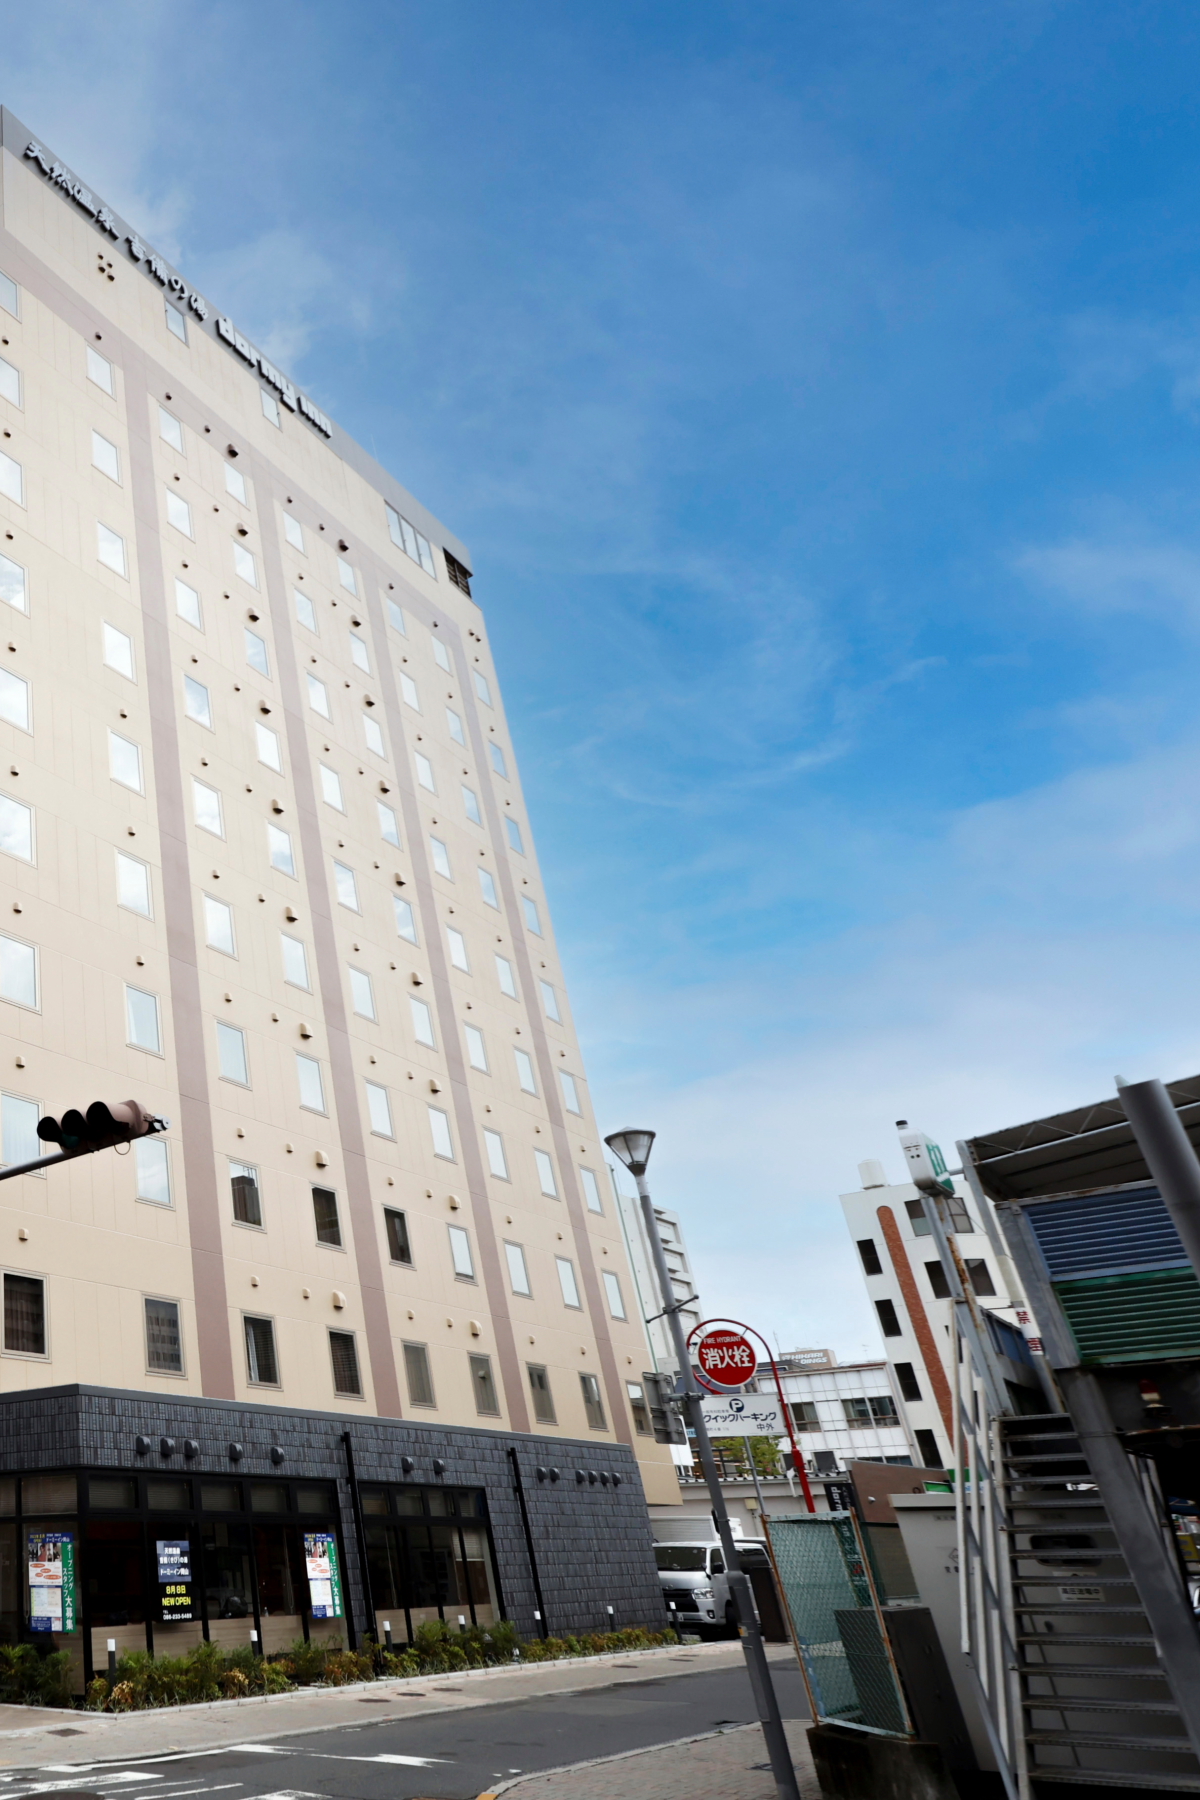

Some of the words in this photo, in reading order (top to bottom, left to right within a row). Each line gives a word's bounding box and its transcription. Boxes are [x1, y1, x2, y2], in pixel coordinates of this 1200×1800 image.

[24, 139, 120, 240] 天然温泉
[126, 233, 210, 322] 吉備の湯
[216, 316, 297, 413] dormy
[297, 394, 333, 439] inn
[703, 1336, 716, 1345] FIRE
[716, 1335, 742, 1344] HYDRANT
[701, 1345, 753, 1370] 消火栓
[791, 1352, 824, 1360] HIKARI
[756, 1422, 775, 1432] 中外
[66, 1543, 74, 1591] オープニング
[65, 1595, 74, 1631] 大募集
[162, 1597, 175, 1606] NEW
[175, 1596, 191, 1606] OPEN
[333, 1587, 342, 1615] 大募集
